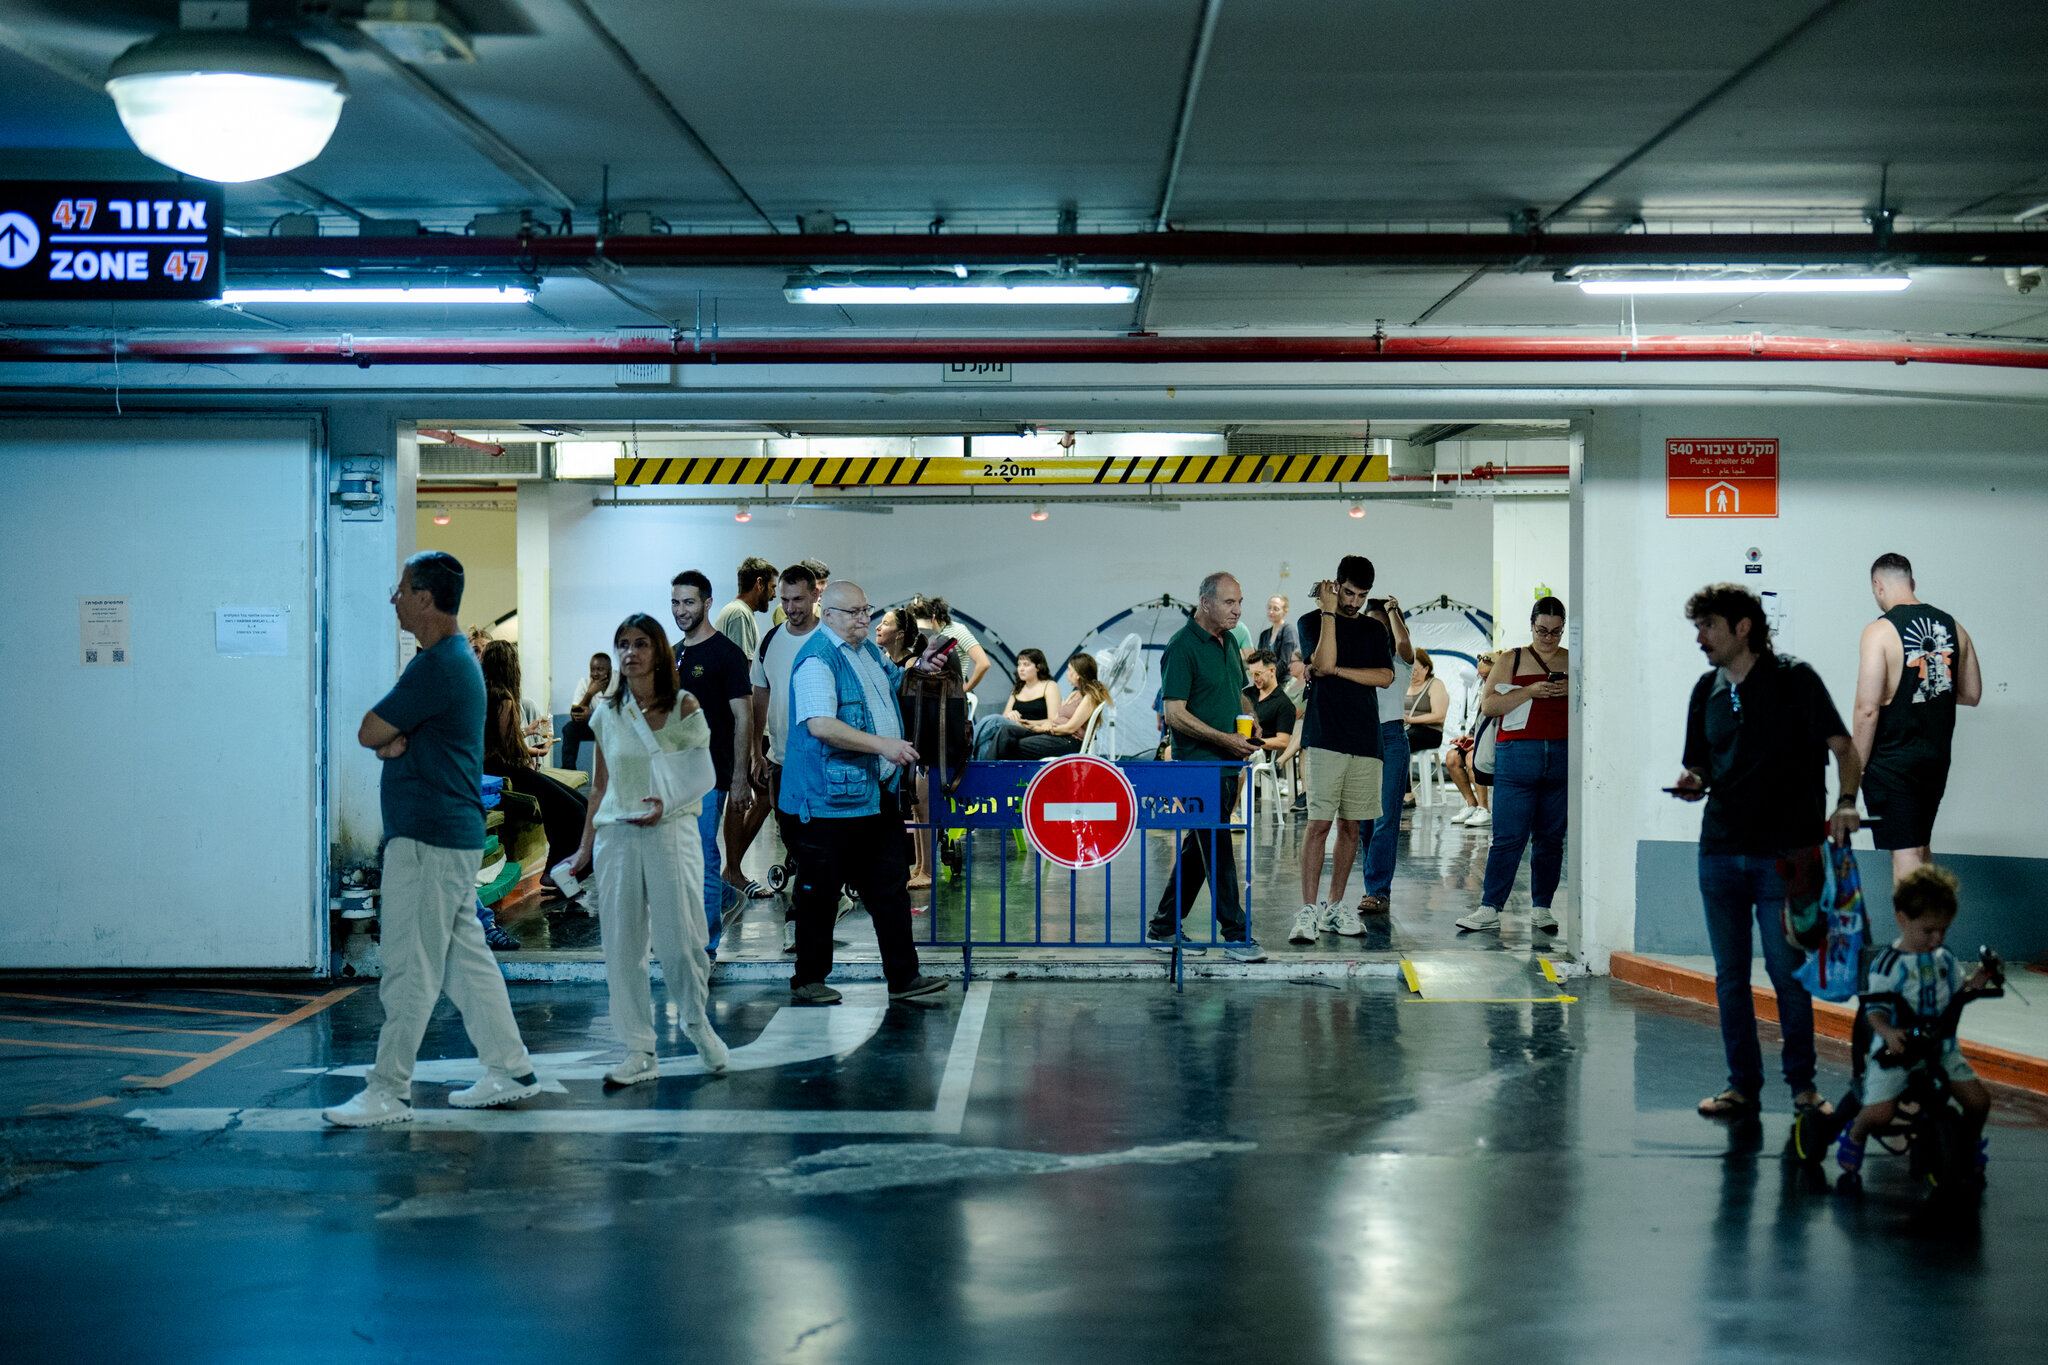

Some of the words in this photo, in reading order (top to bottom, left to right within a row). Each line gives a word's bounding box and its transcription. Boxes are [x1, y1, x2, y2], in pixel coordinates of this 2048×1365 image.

[52, 199, 97, 230] 47
[108, 200, 208, 230] אזור
[49, 250, 149, 281] ZONE
[163, 250, 208, 281] 47
[1670, 443, 1694, 456] 540
[1696, 444, 1735, 456] ציבורי
[1738, 442, 1775, 458] מקלט
[1690, 457, 1713, 465] Public
[1714, 457, 1739, 465] shelter
[1740, 457, 1755, 465] 540
[983, 464, 1036, 477] 2.20m
[1141, 796, 1204, 819] האגף
